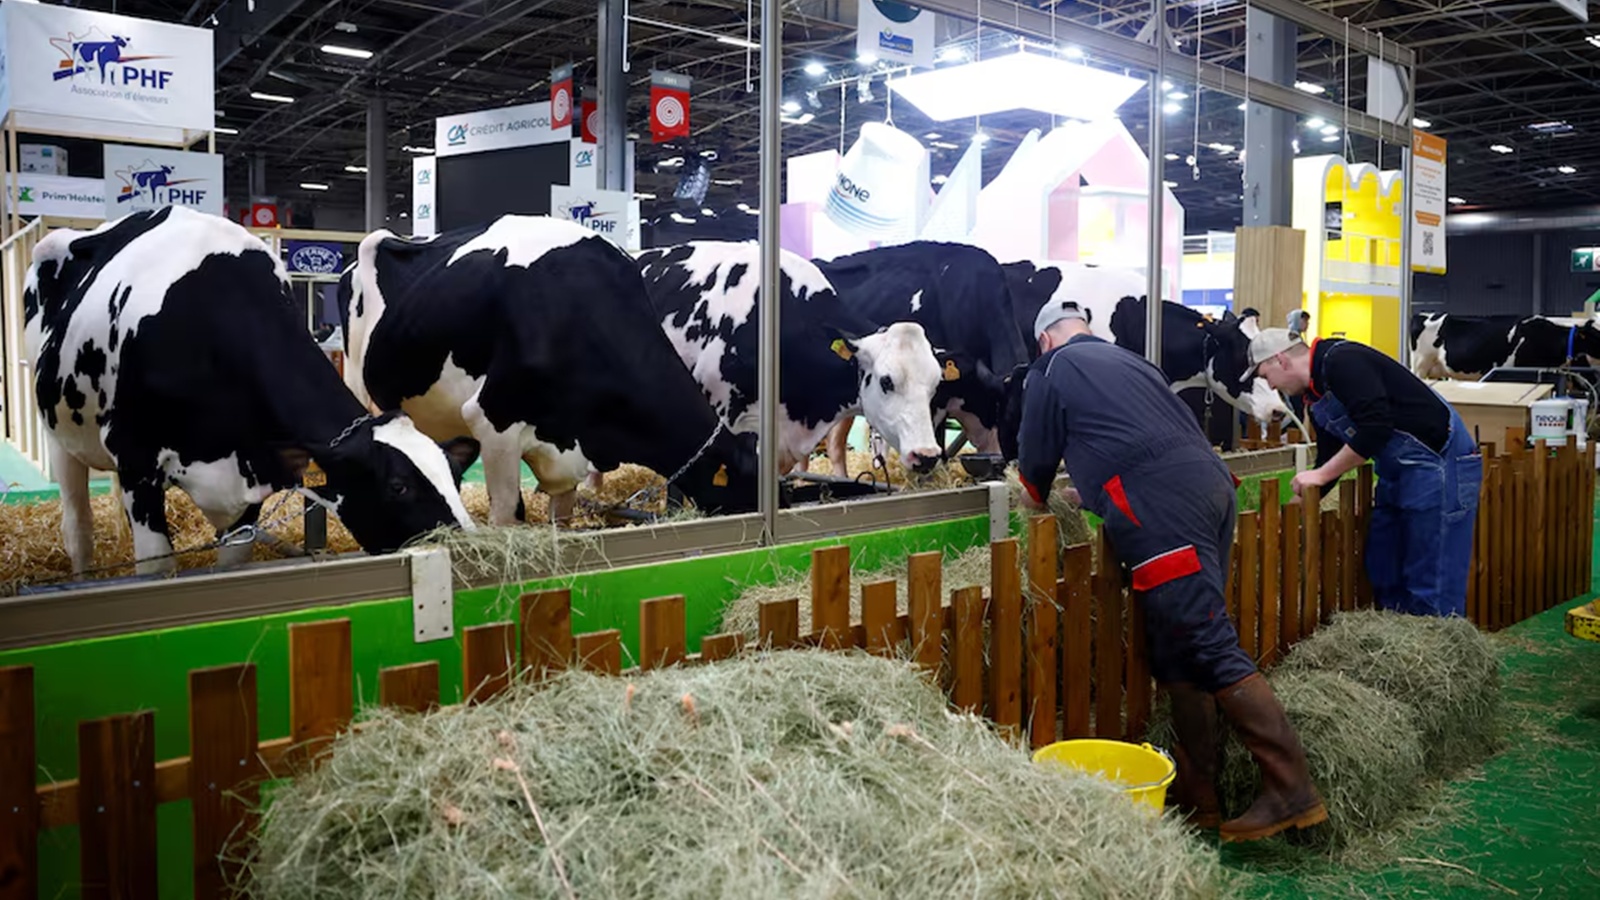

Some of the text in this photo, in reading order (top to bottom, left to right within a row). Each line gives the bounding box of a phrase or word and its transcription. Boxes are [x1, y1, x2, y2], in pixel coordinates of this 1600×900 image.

[123, 66, 173, 89] PHF
[71, 84, 123, 99] Association
[506, 117, 550, 131] AGRICOL
[42, 191, 105, 204] Prim'Holstei
[169, 188, 207, 205] PHF
[592, 219, 617, 233] PHF
